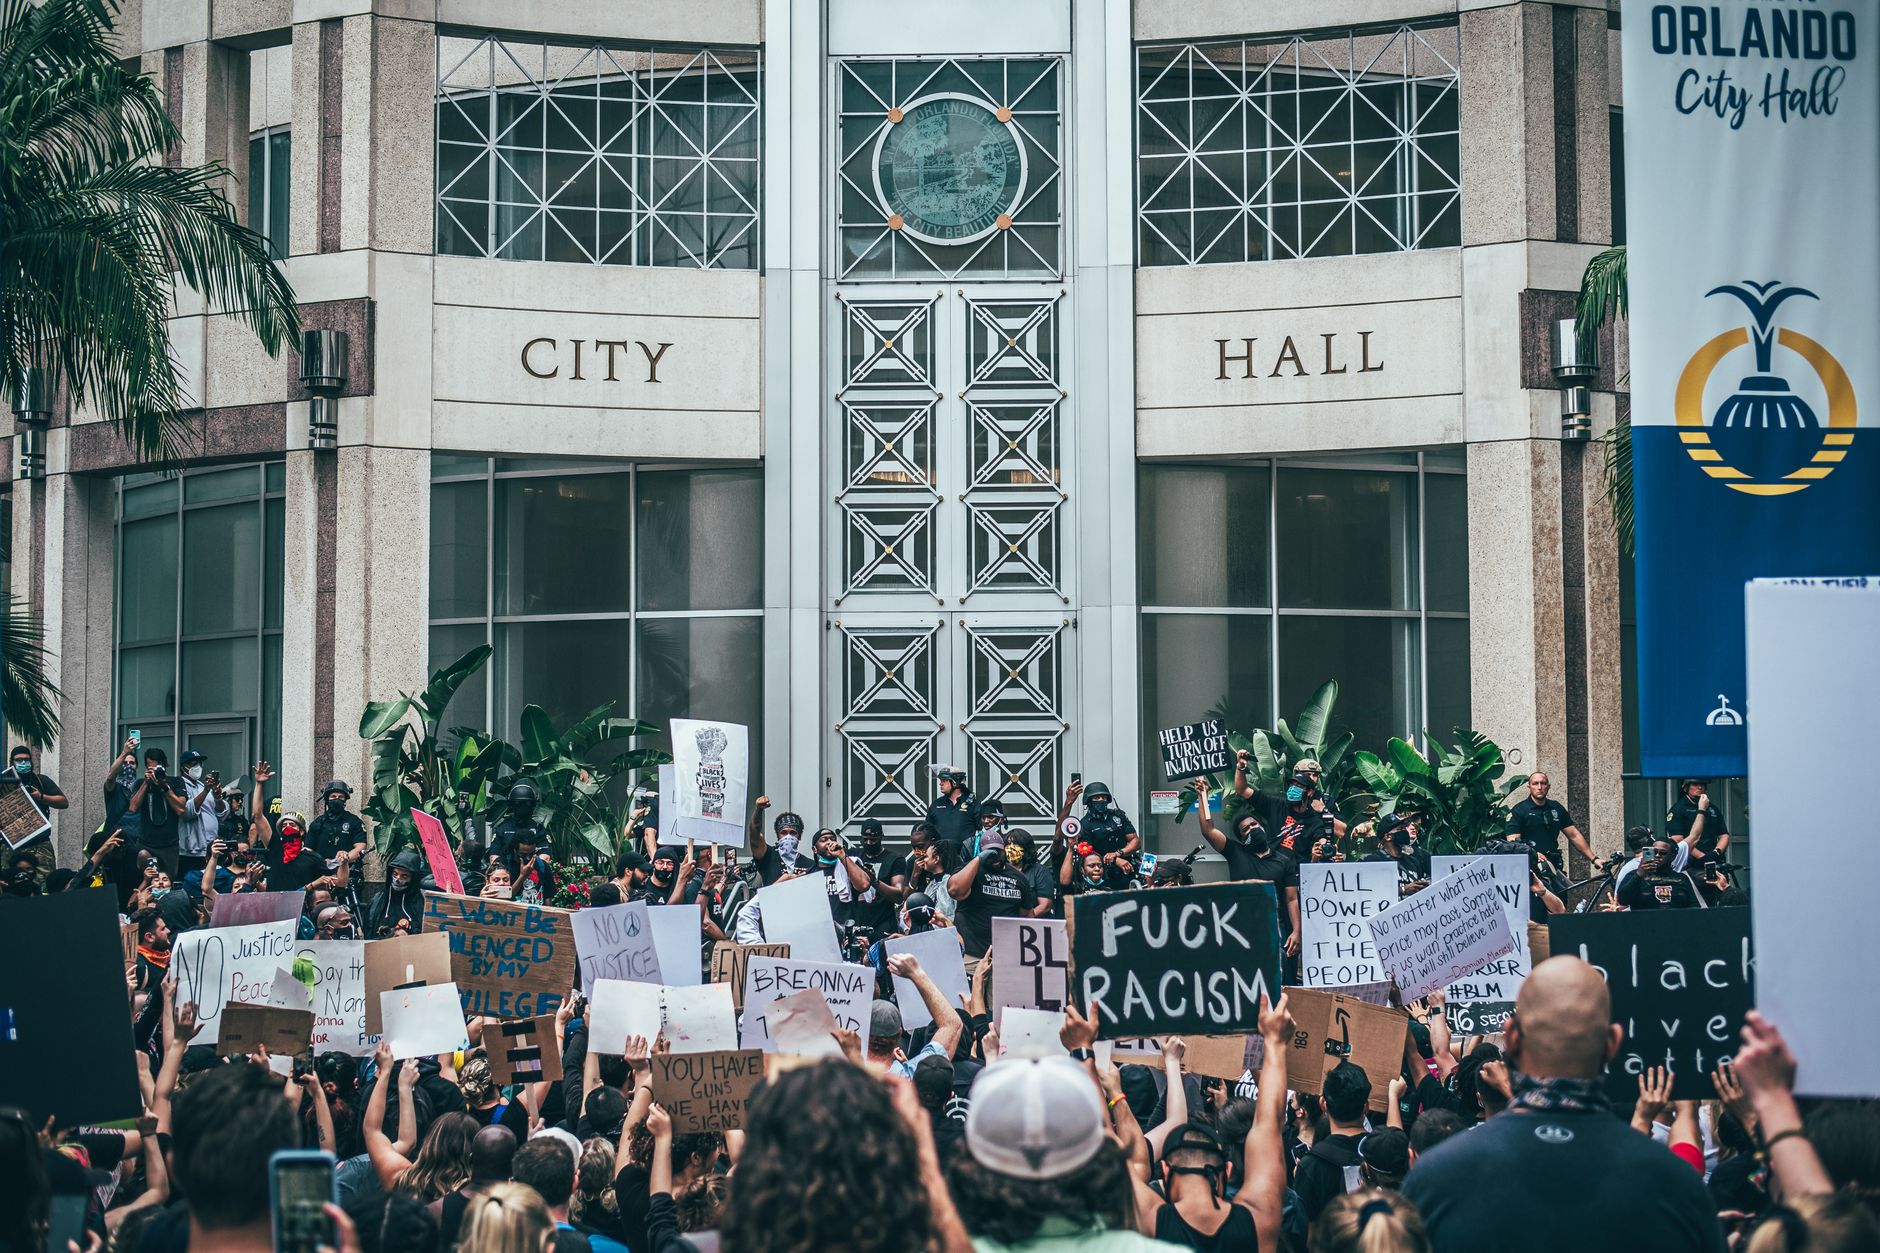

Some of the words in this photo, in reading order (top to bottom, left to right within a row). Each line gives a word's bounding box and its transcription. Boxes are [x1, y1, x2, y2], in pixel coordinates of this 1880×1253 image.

[1651, 5, 1856, 61] ORLANDO
[1675, 68, 1753, 130] City
[1759, 65, 1846, 123] Hall
[912, 218, 943, 238] CITY
[521, 337, 675, 384] CITY
[1214, 331, 1384, 380] HALL
[1160, 725, 1193, 745] HELP
[1202, 720, 1218, 737] US
[1167, 739, 1201, 760] TURN
[1204, 735, 1227, 752] OFF
[702, 768, 720, 776] BLACK
[1165, 752, 1227, 776] INJUSTICE
[701, 780, 720, 789] LIVES
[701, 792, 721, 800] MATTER
[1323, 870, 1372, 892] ALL
[424, 895, 449, 918] I
[458, 901, 522, 927] WONT
[524, 906, 559, 934] BE
[1369, 920, 1390, 941] No
[1392, 894, 1436, 929] matter
[1439, 877, 1465, 902] what
[1466, 868, 1489, 887] the
[592, 913, 620, 948] NO
[1102, 900, 1251, 957] FUCK
[1329, 921, 1361, 939] TO
[1378, 935, 1412, 969] price
[1414, 920, 1438, 942] may
[1440, 906, 1461, 927] cost
[1399, 957, 1413, 972] us
[1443, 914, 1479, 946] practice
[1479, 901, 1500, 921] hate
[1313, 941, 1374, 959] THE
[1411, 970, 1417, 984] I
[1418, 958, 1436, 978] will
[1437, 944, 1455, 966] still
[1455, 928, 1487, 953] believe
[1488, 919, 1498, 932] in
[173, 935, 224, 1020] NO
[233, 931, 294, 960] Justice
[469, 958, 494, 976] BY
[497, 961, 530, 977] MY
[584, 946, 656, 985] JUSTICE
[751, 966, 866, 993] BREONNA
[1411, 979, 1439, 999] LOVE
[1448, 982, 1503, 999] #BLM
[1083, 966, 1274, 1024] RACISM
[1446, 1006, 1475, 1032] 46
[1294, 1031, 1308, 1049] 1BG
[658, 1057, 704, 1081] YOU
[712, 1056, 759, 1080] HAVE
[691, 1081, 732, 1099] GUNS
[655, 1100, 692, 1116] WE
[689, 1114, 741, 1131] SIGNS
